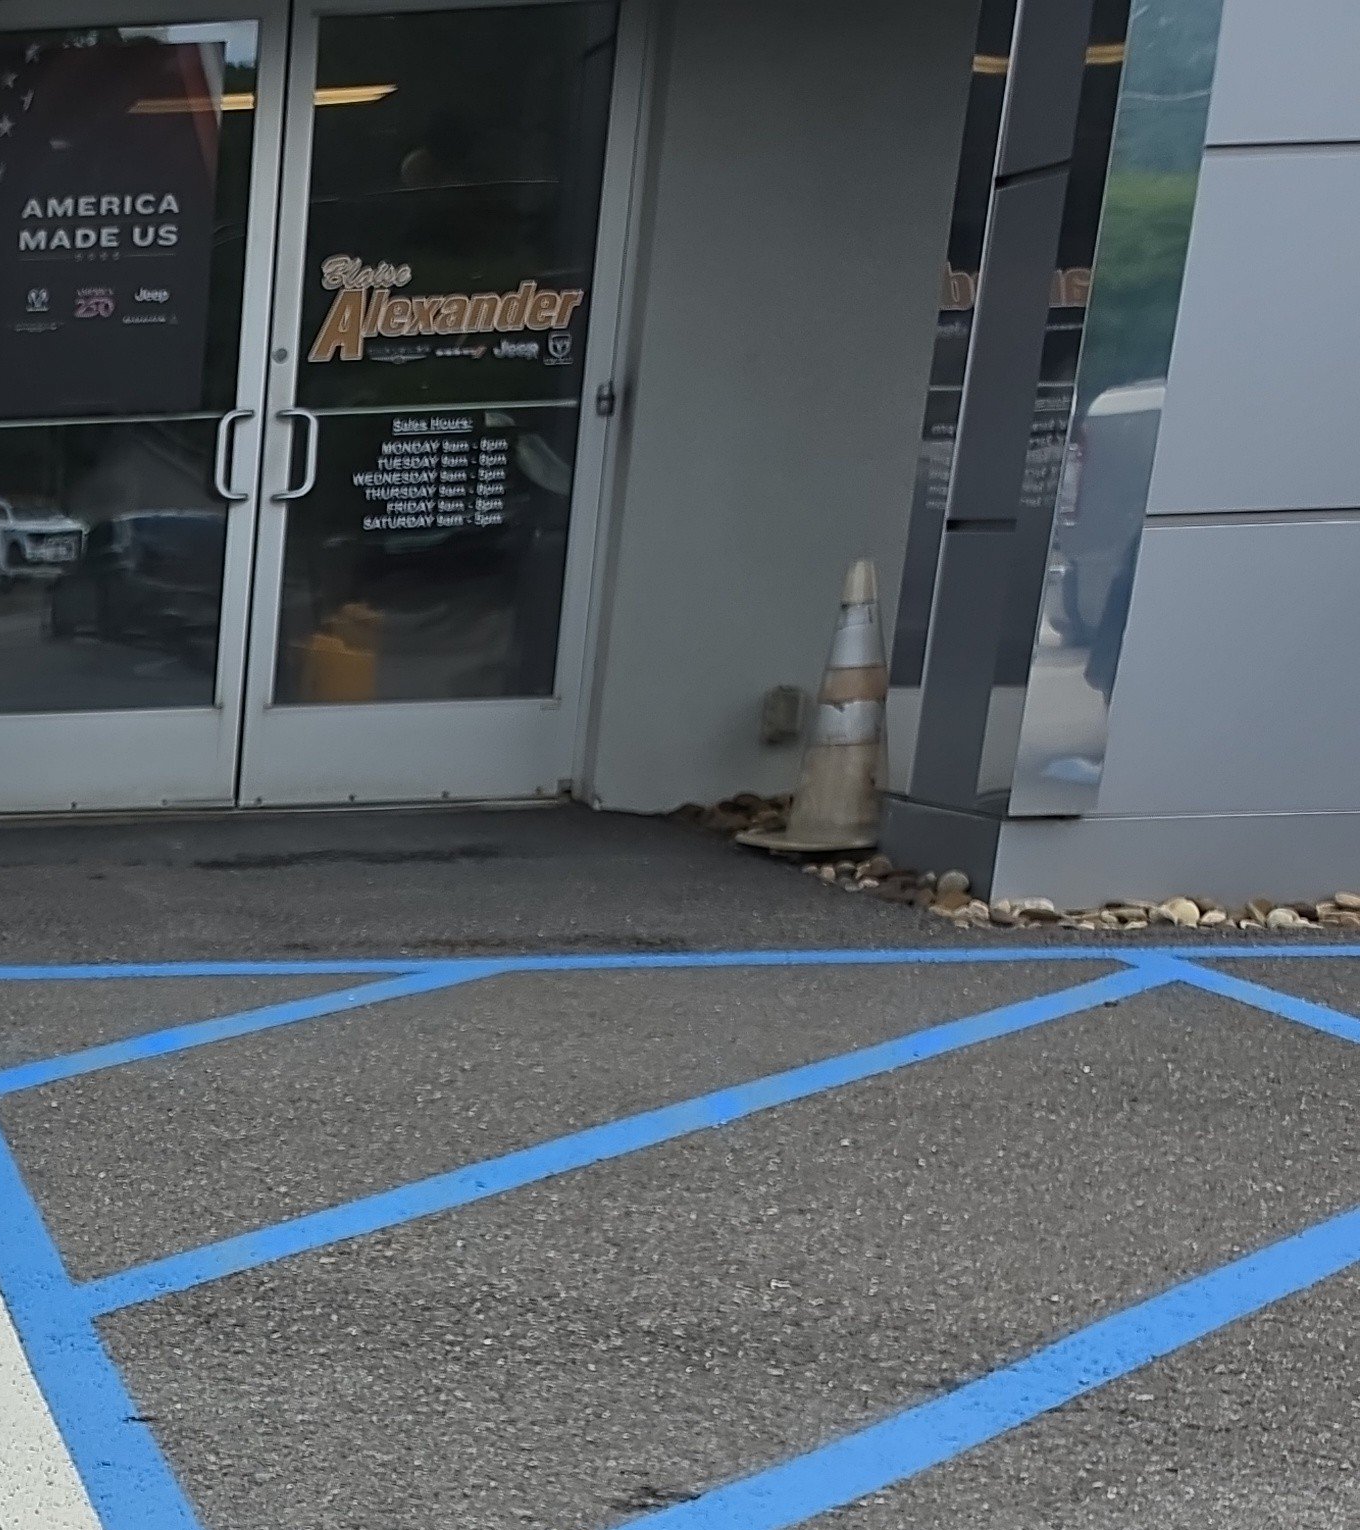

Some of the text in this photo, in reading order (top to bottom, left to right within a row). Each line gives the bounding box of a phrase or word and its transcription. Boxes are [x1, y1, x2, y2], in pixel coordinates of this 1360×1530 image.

[21, 193, 179, 219] AMERICA
[18, 224, 179, 251] MADE US
[321, 253, 412, 291] Blaise
[134, 286, 170, 304] Jeep
[307, 280, 584, 363] Alexander
[492, 338, 540, 359] Jeep
[392, 417, 428, 434] Sales
[381, 439, 440, 455] MONDAY
[378, 454, 440, 470] TUESDAY
[352, 469, 438, 487] WEDNESDAY
[365, 484, 437, 500] THURSDAY
[386, 499, 436, 515] FRIDAY
[363, 514, 435, 530] SATURDAY
